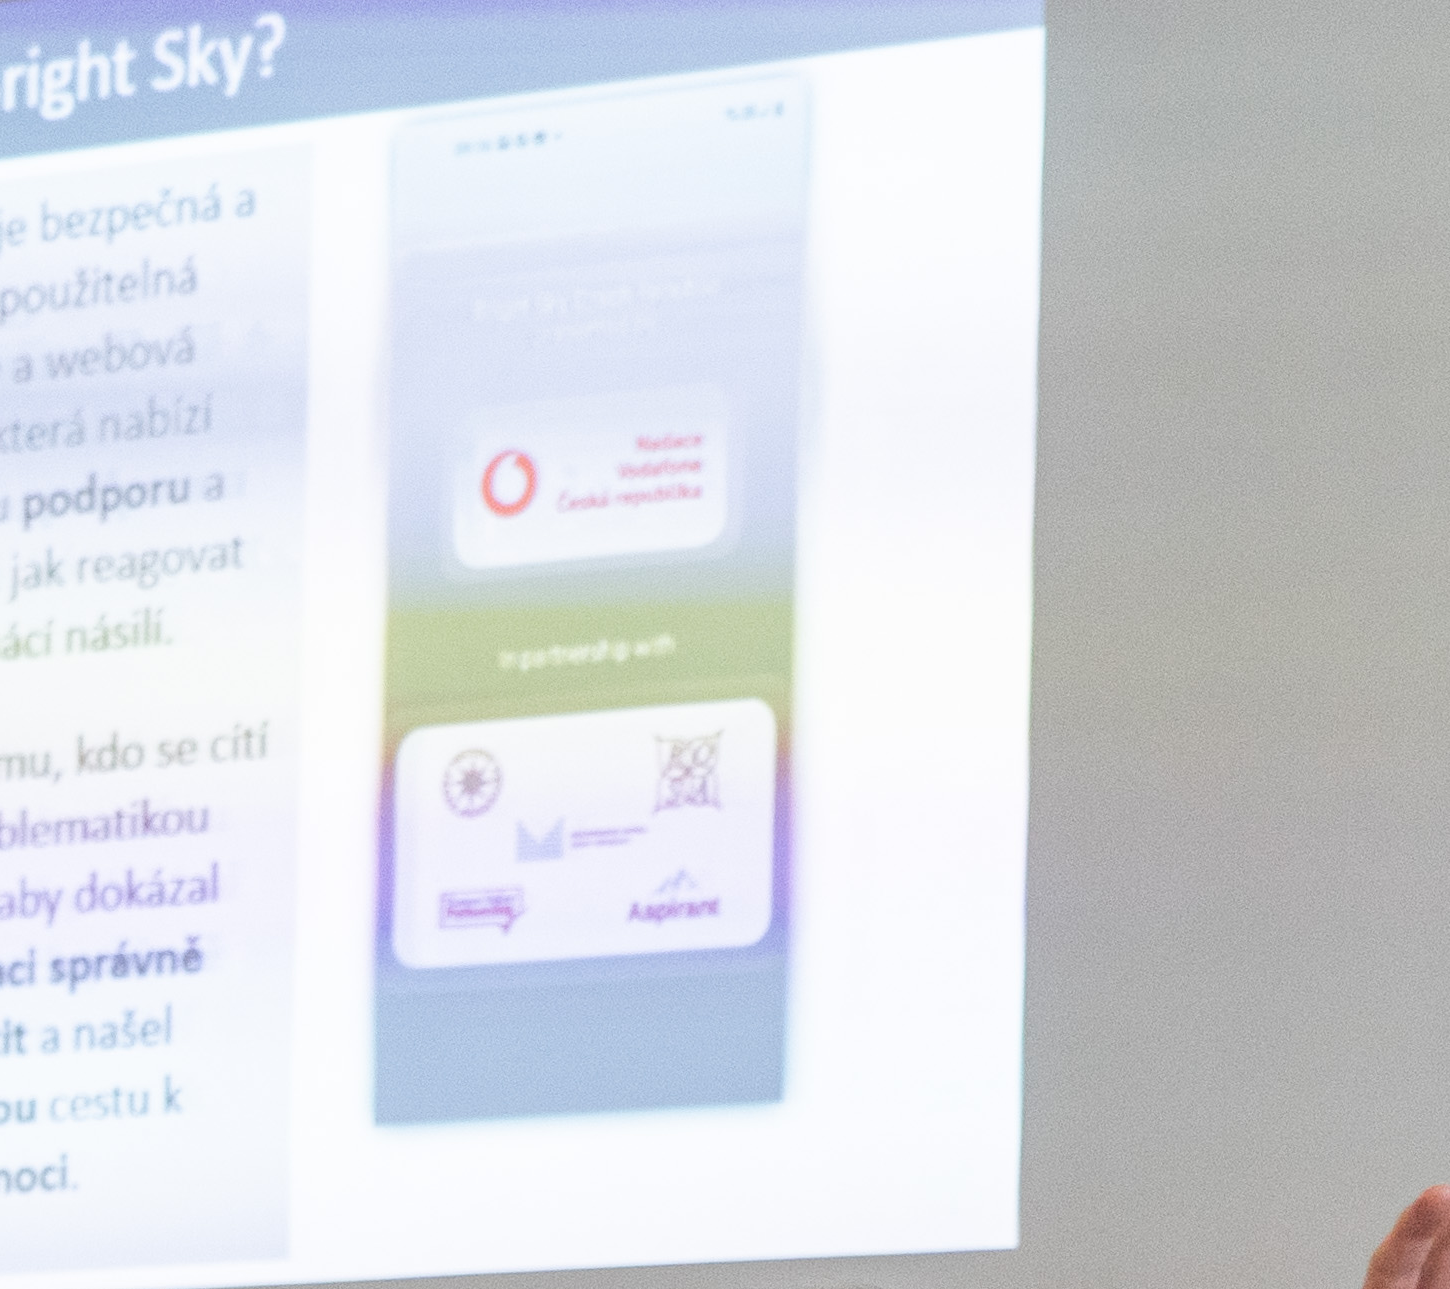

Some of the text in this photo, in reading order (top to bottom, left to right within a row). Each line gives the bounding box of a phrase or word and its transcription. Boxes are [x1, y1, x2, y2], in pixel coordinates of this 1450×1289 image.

[154, 13, 287, 95] Sky?
[41, 183, 220, 242] bezpečná
[236, 190, 256, 218] a
[0, 255, 198, 324] použitelná
[13, 355, 31, 383] a
[48, 329, 195, 379] webová
[99, 395, 213, 441] nabízí
[24, 466, 188, 527] podporu
[203, 472, 225, 501] a
[8, 550, 64, 600] jak
[78, 537, 243, 587] reagovat
[66, 608, 172, 655] násilí.
[77, 735, 143, 773] kdo
[158, 738, 196, 765] se
[211, 722, 268, 762] cítí
[76, 864, 220, 913] dokázal
[50, 936, 203, 992] správně
[42, 1024, 59, 1054] a
[74, 1007, 171, 1049] našel
[50, 1085, 148, 1121] cestu
[166, 1078, 181, 1112] k
